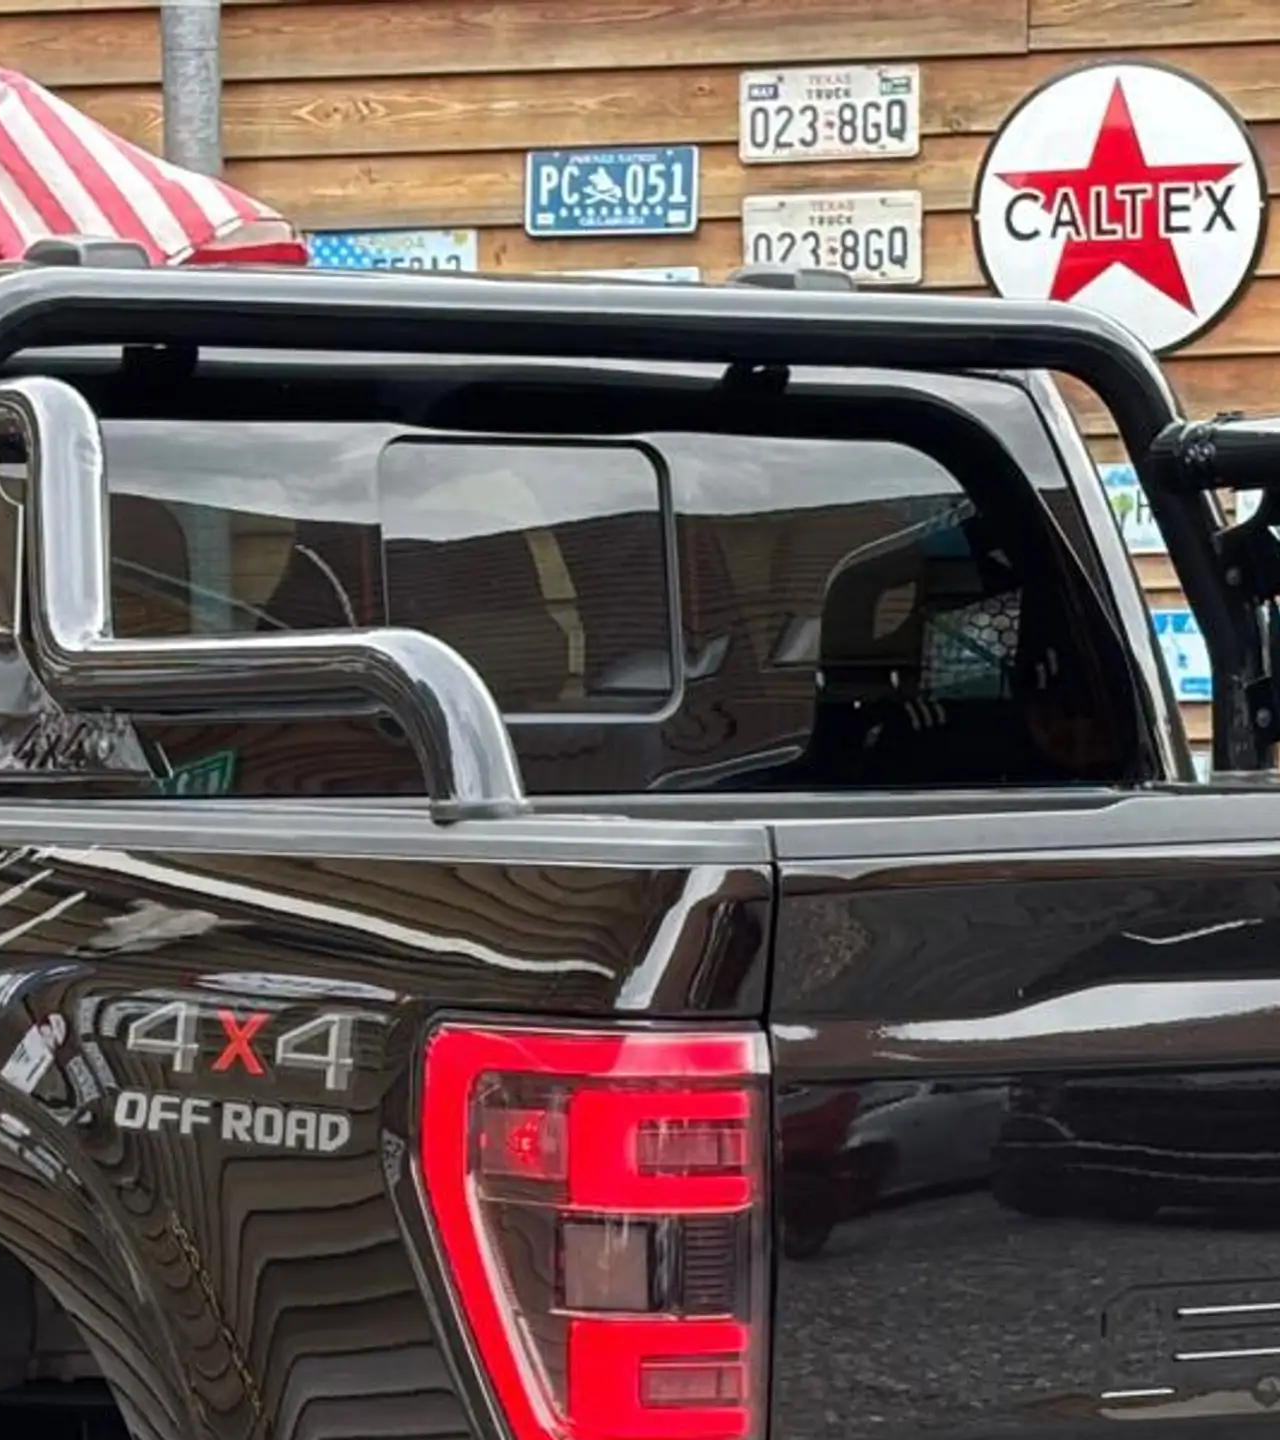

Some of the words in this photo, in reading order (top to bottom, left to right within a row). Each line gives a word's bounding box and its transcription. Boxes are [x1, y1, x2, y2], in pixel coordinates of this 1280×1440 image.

[1004, 184, 1237, 242] CALTEX
[113, 1091, 212, 1135] OFF
[221, 1102, 352, 1152] ROAD
